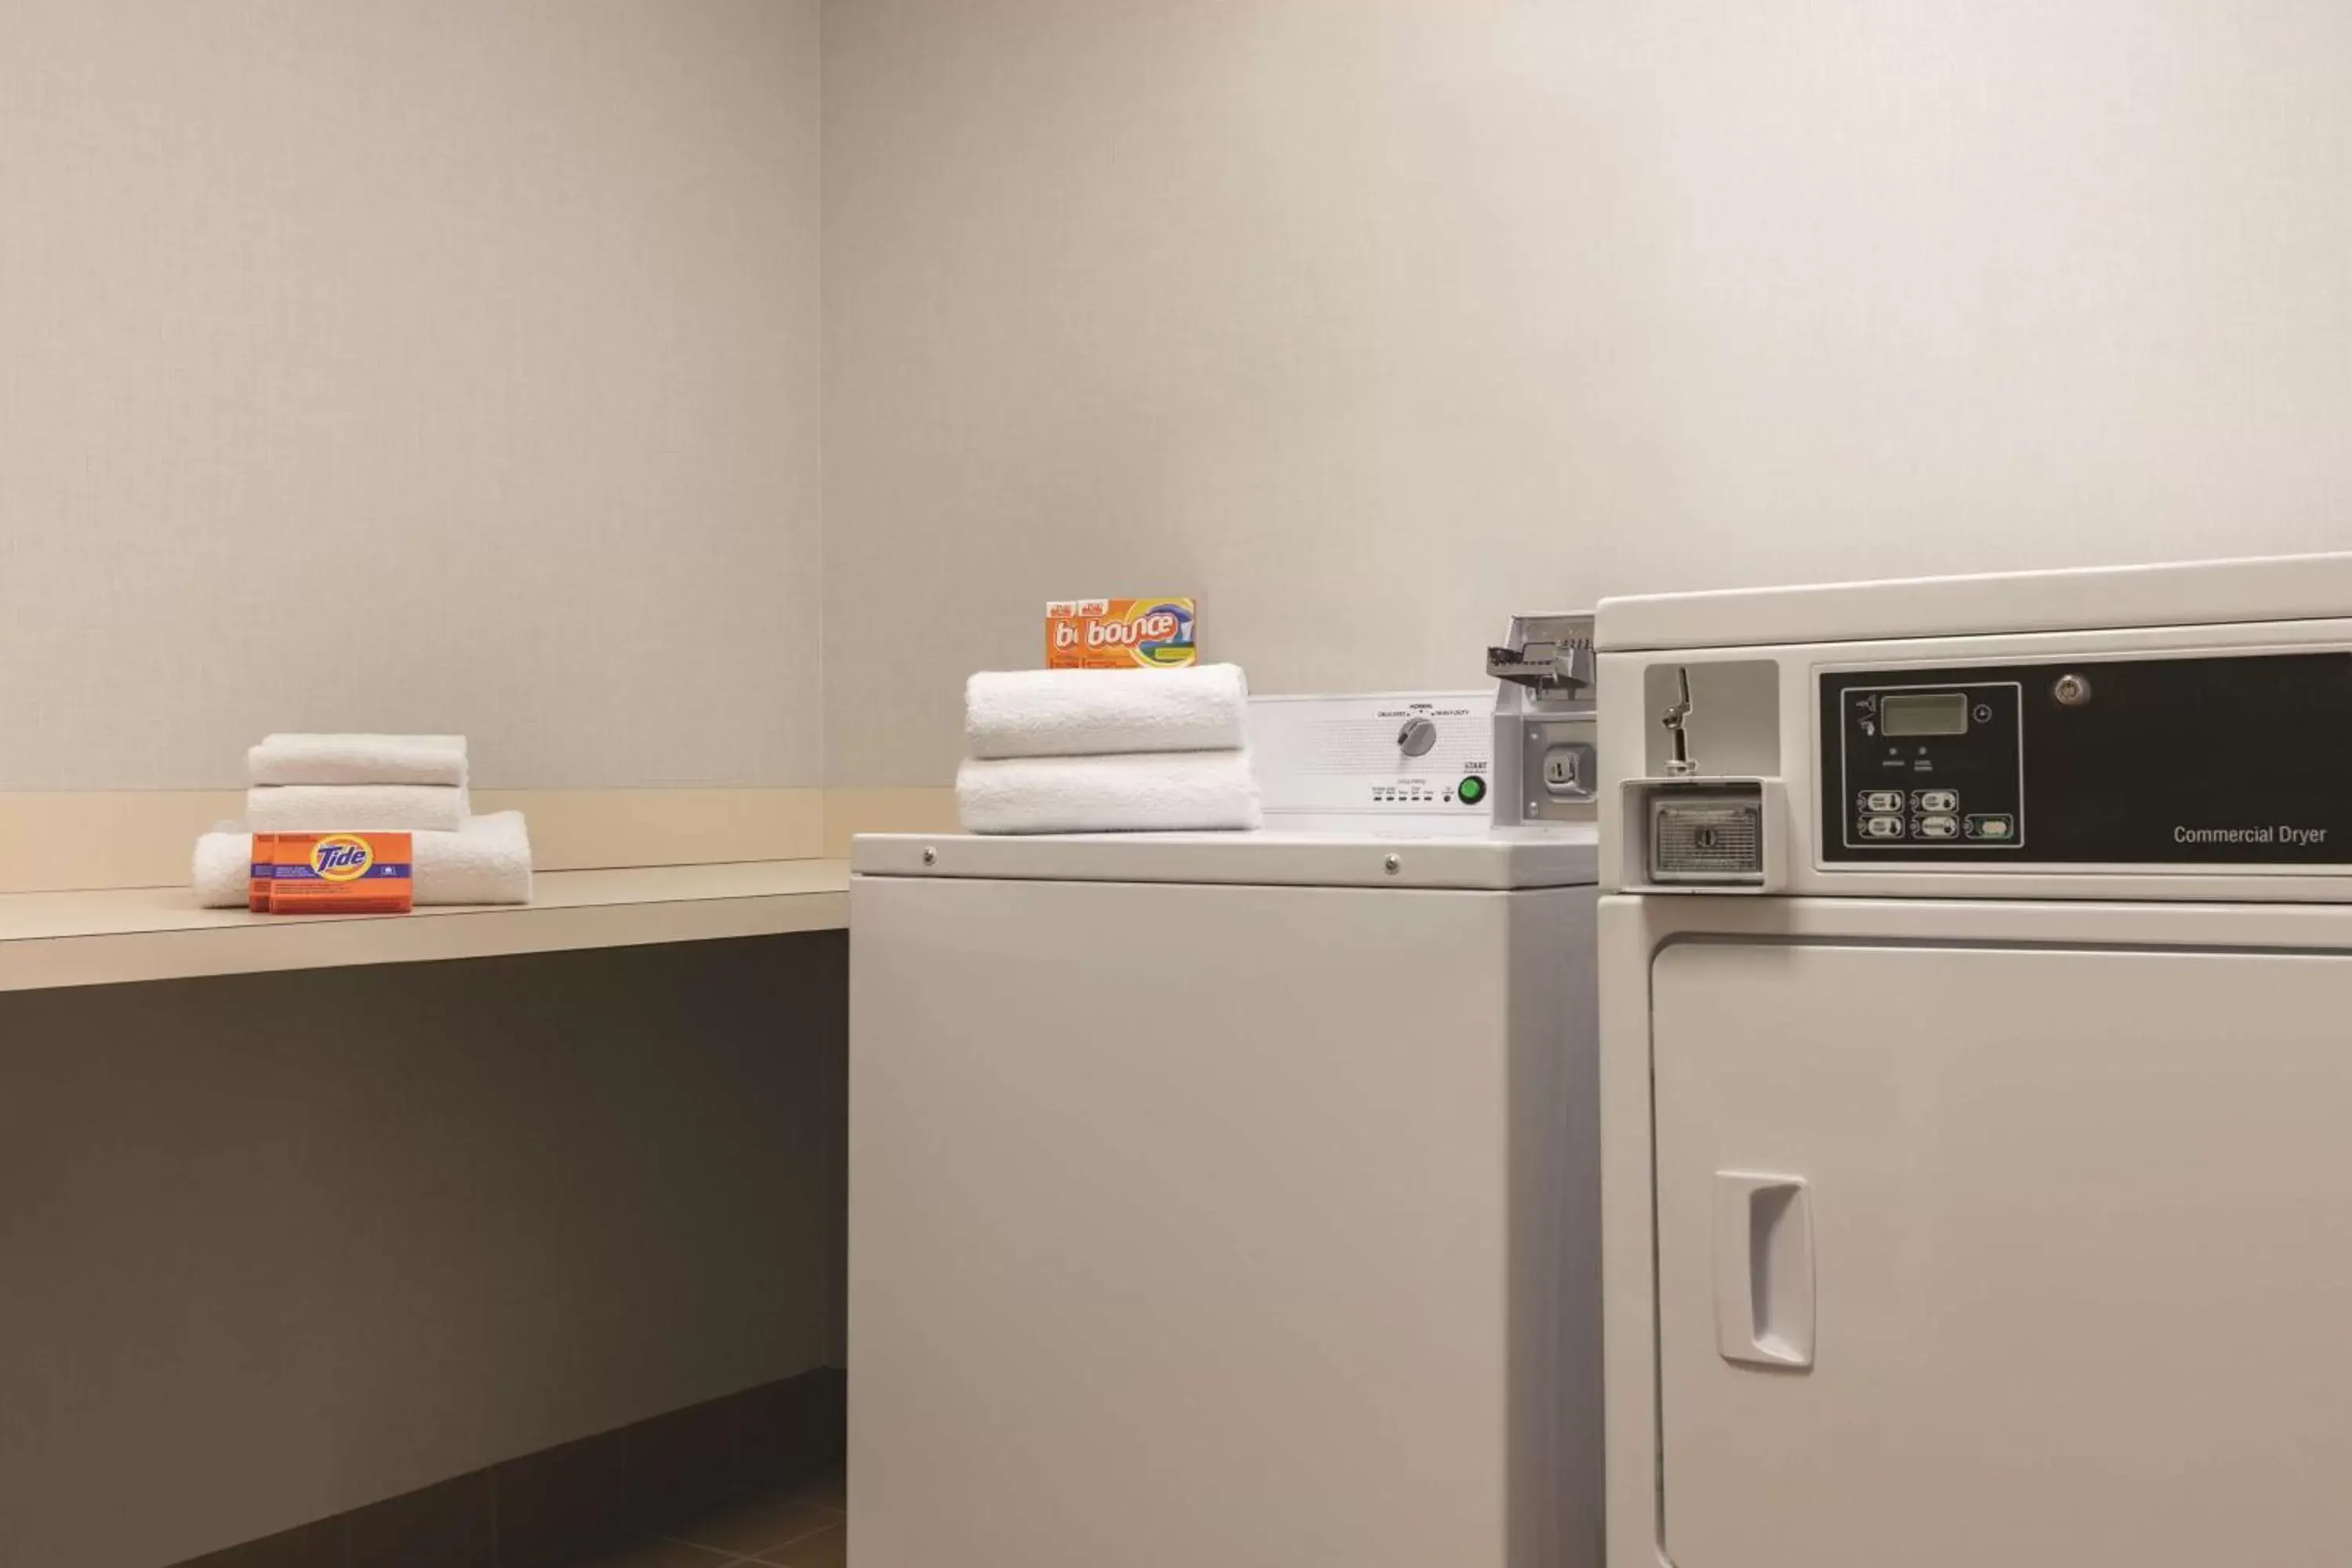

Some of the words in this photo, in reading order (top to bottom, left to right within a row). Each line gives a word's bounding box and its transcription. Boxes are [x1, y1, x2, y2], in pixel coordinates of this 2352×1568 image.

[1087, 615, 1174, 646] bounce
[2173, 826, 2274, 844] Commercial
[2279, 826, 2327, 846] Dryer
[318, 846, 367, 872] Tide
